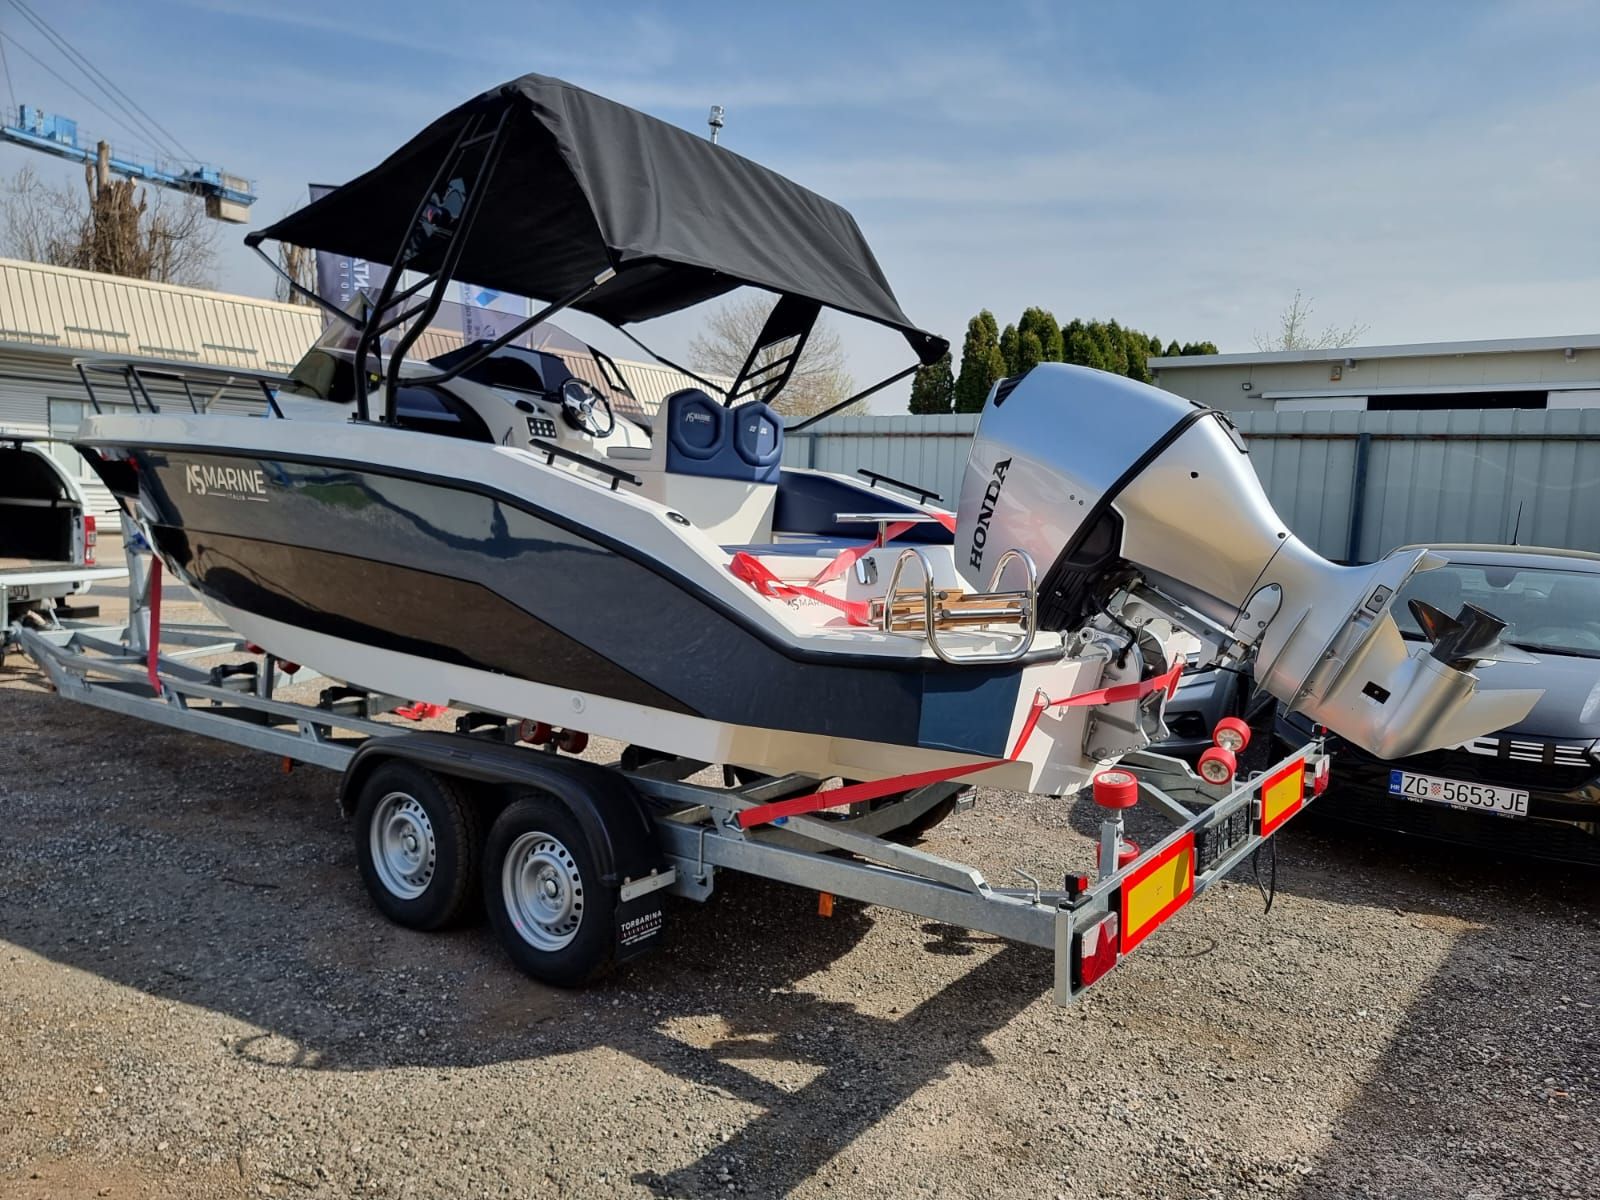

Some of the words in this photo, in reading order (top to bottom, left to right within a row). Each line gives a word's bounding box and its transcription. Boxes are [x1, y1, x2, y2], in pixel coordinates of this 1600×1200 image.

[970, 457, 1012, 572] HONDA
[1404, 775, 1428, 796] ZG
[621, 910, 662, 931] TORBARINA
